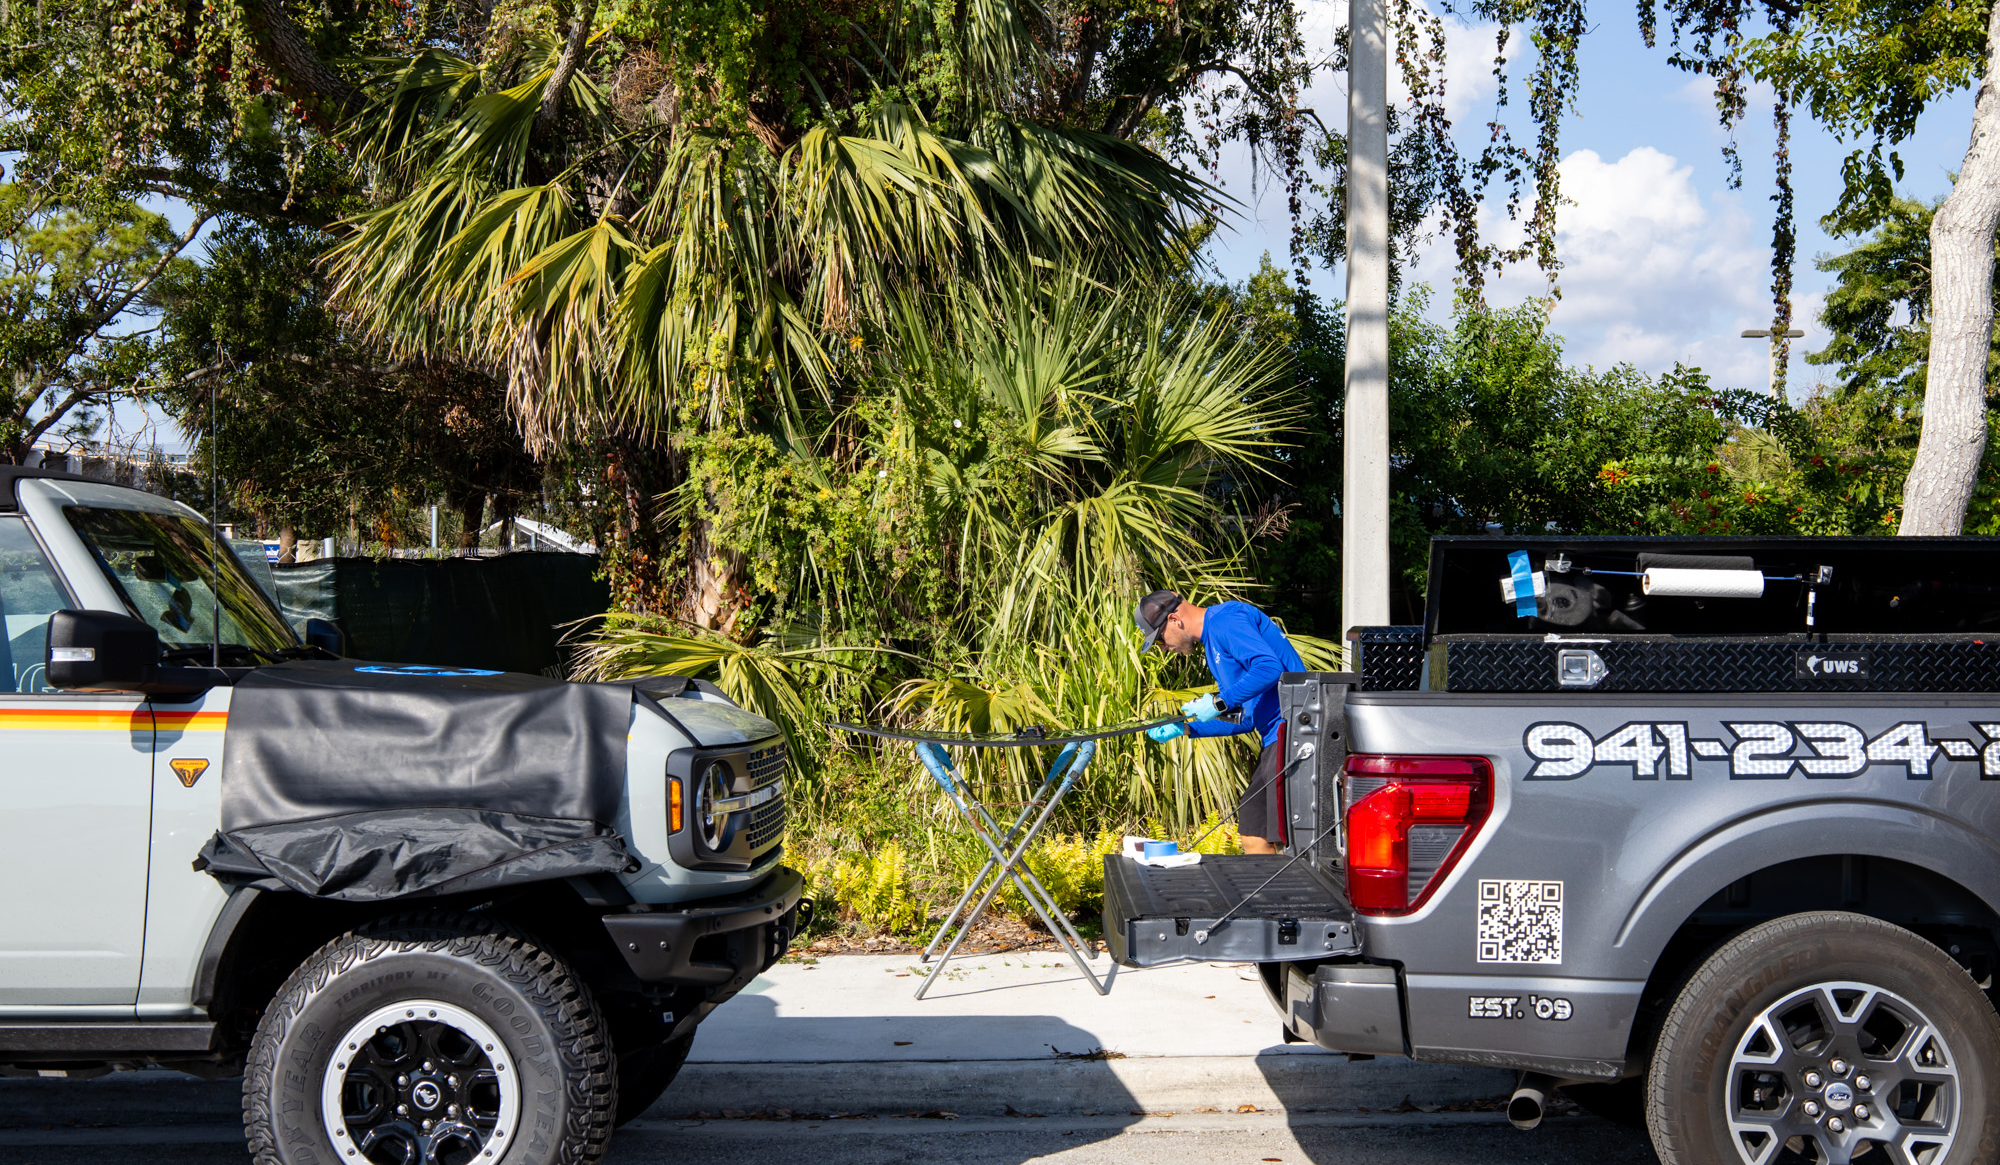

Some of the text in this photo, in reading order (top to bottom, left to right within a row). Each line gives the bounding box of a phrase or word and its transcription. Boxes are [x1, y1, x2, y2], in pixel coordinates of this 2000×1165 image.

[1823, 660, 1859, 674] UWS
[335, 970, 414, 1008] TERRITORY
[1468, 994, 1574, 1021] EST. '09
[472, 982, 562, 1165] GOODYEA
